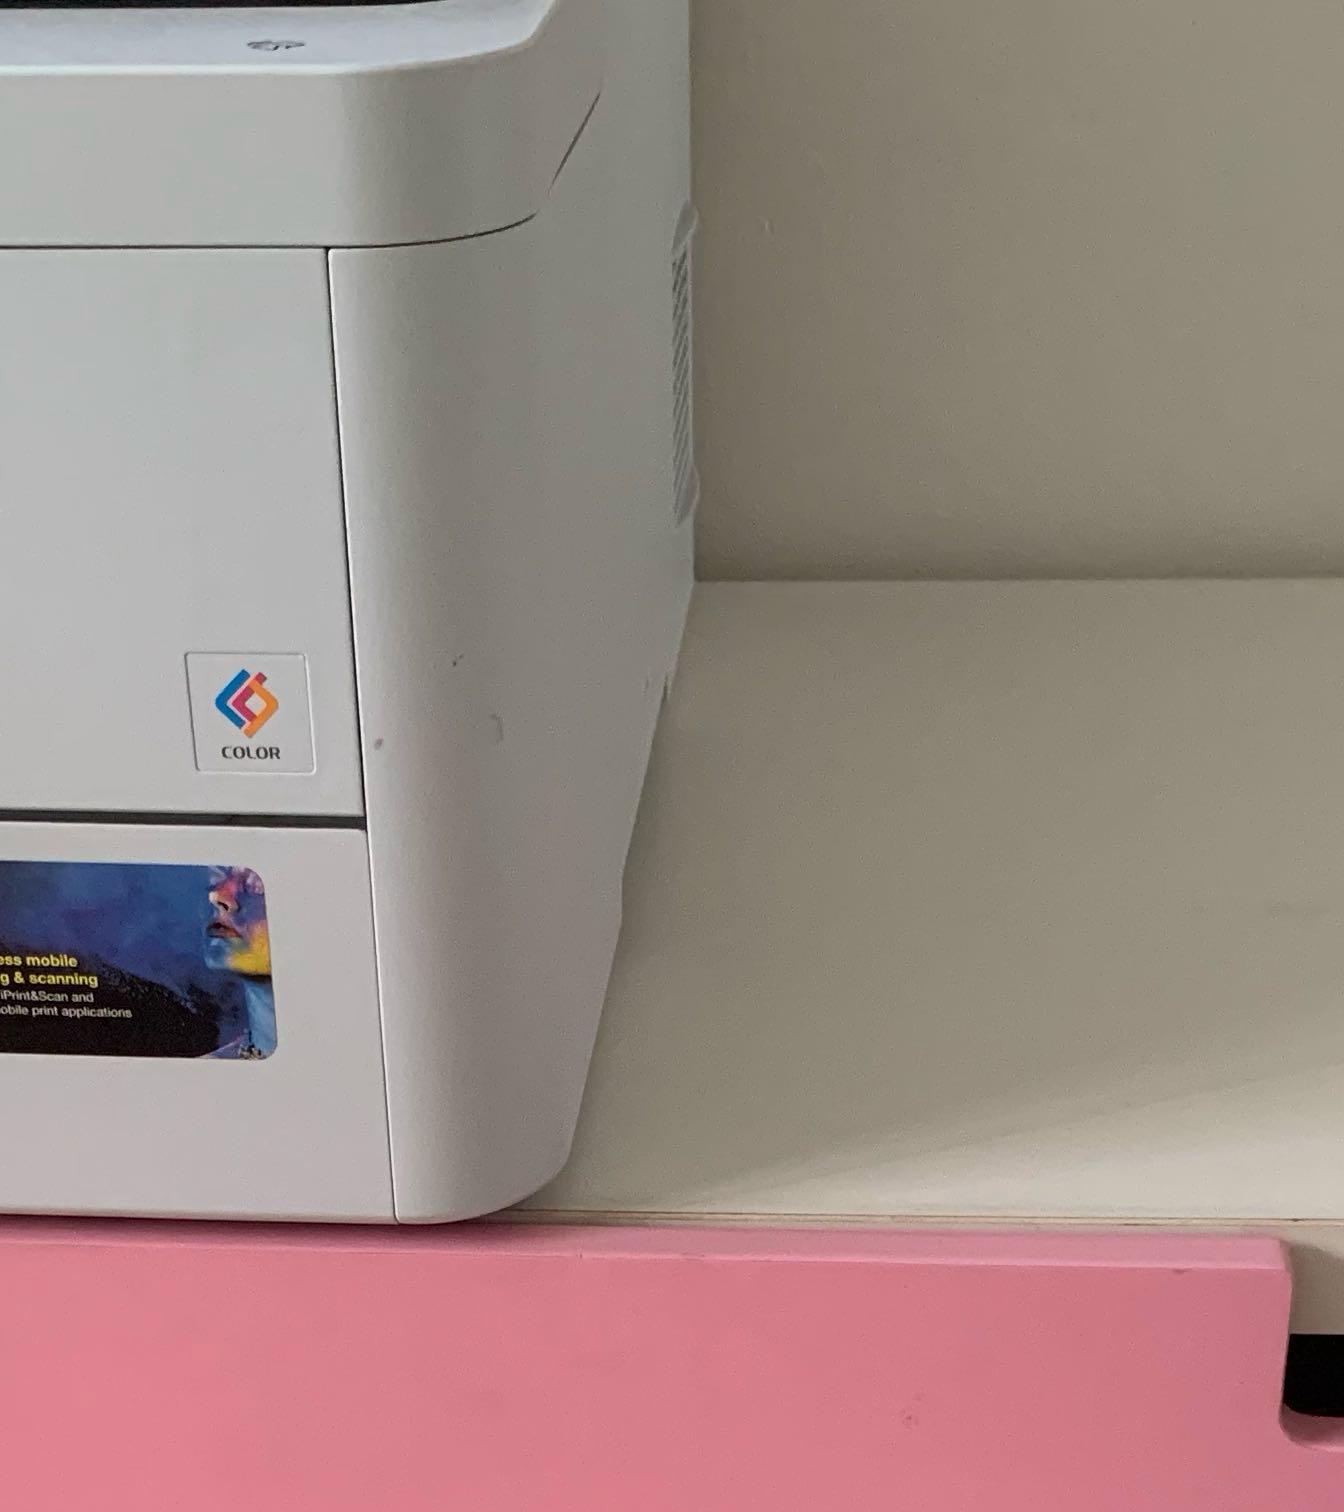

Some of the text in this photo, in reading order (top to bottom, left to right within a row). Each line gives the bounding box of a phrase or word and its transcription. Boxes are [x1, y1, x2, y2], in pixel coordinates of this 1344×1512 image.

[221, 745, 281, 760] COLOR
[26, 953, 78, 968] mobile
[13, 971, 25, 984] &
[29, 973, 98, 989] scanning
[0, 990, 69, 1002] iPrint&Scan
[71, 991, 94, 1003] and
[31, 1005, 58, 1018] print
[61, 1006, 133, 1019] applications
